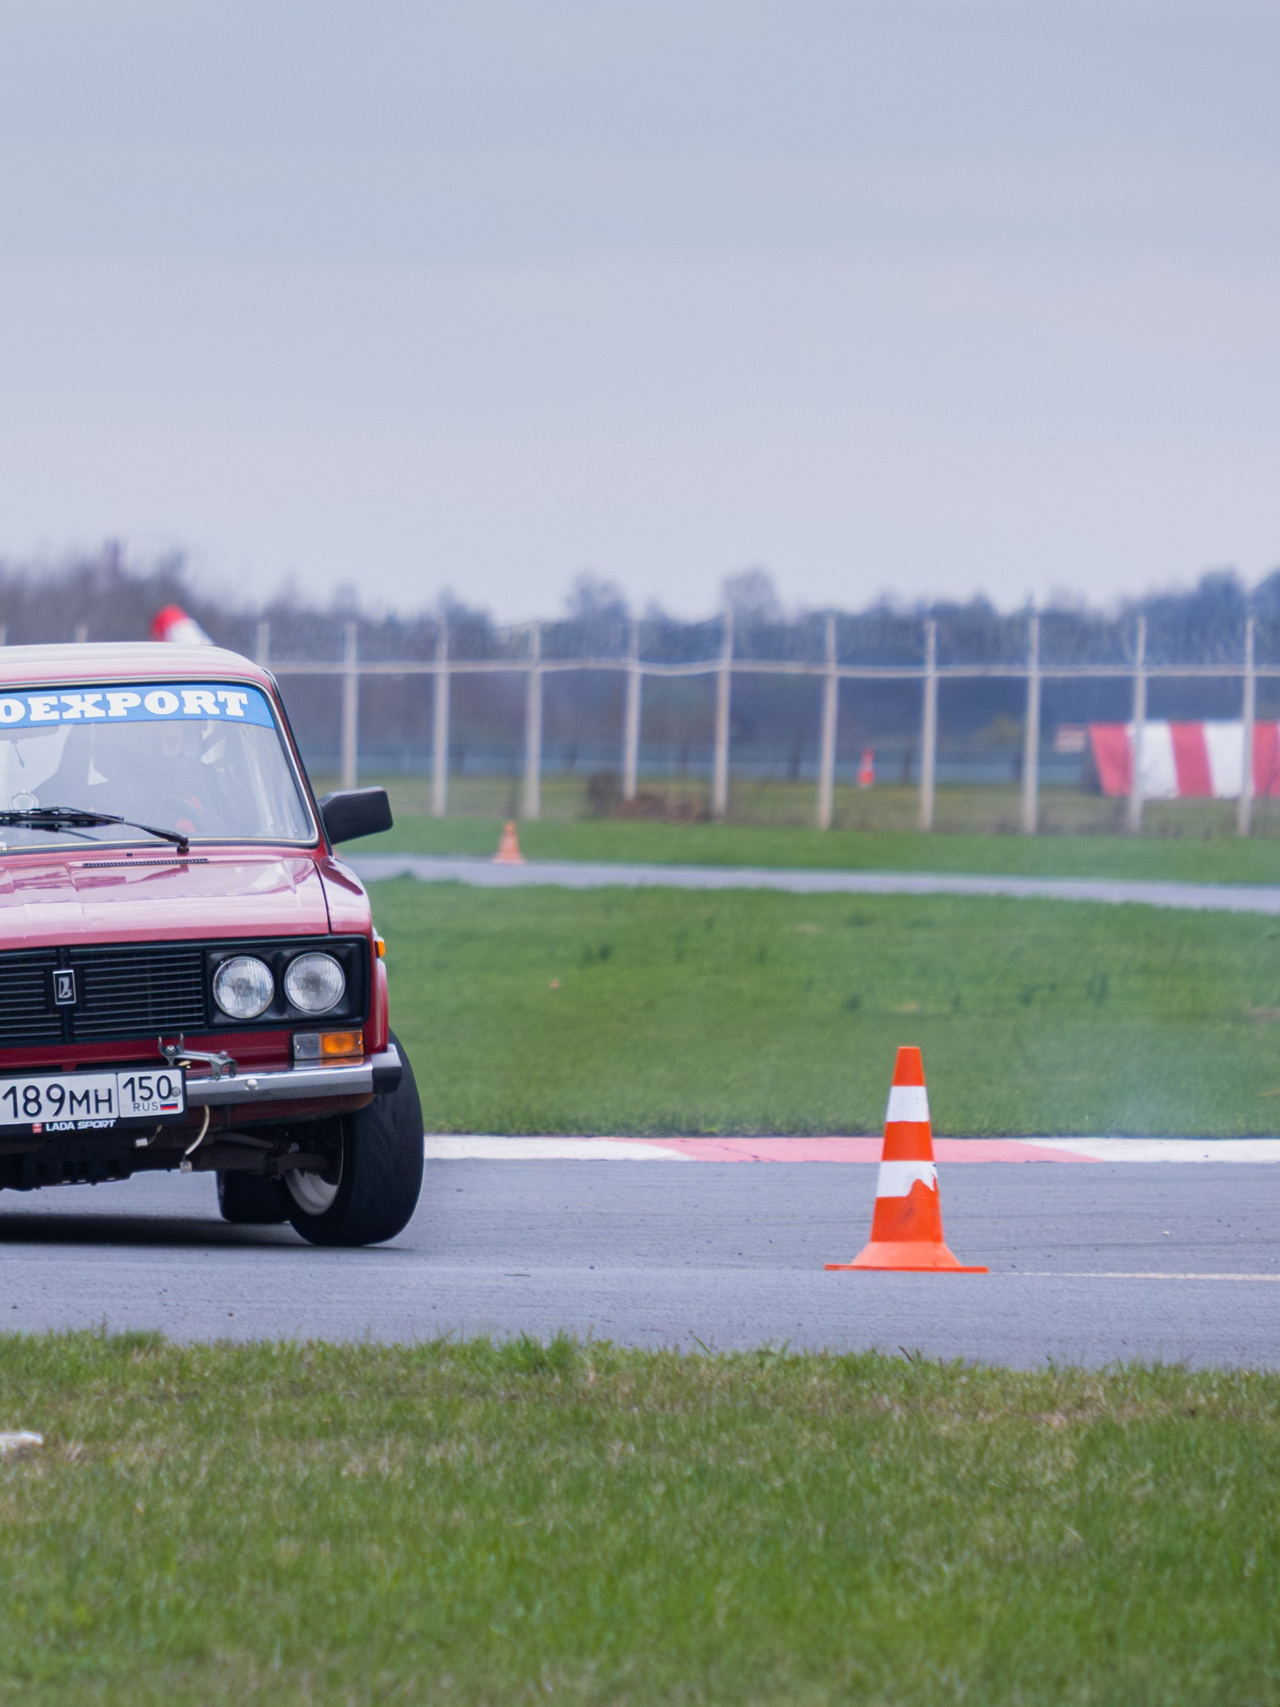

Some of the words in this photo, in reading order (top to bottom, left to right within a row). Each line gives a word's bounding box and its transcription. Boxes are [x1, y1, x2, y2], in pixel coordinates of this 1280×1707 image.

[122, 1075, 173, 1103] 150
[132, 1101, 159, 1113] RUS
[45, 1121, 76, 1132] LADA
[76, 1119, 117, 1130] SPORT
